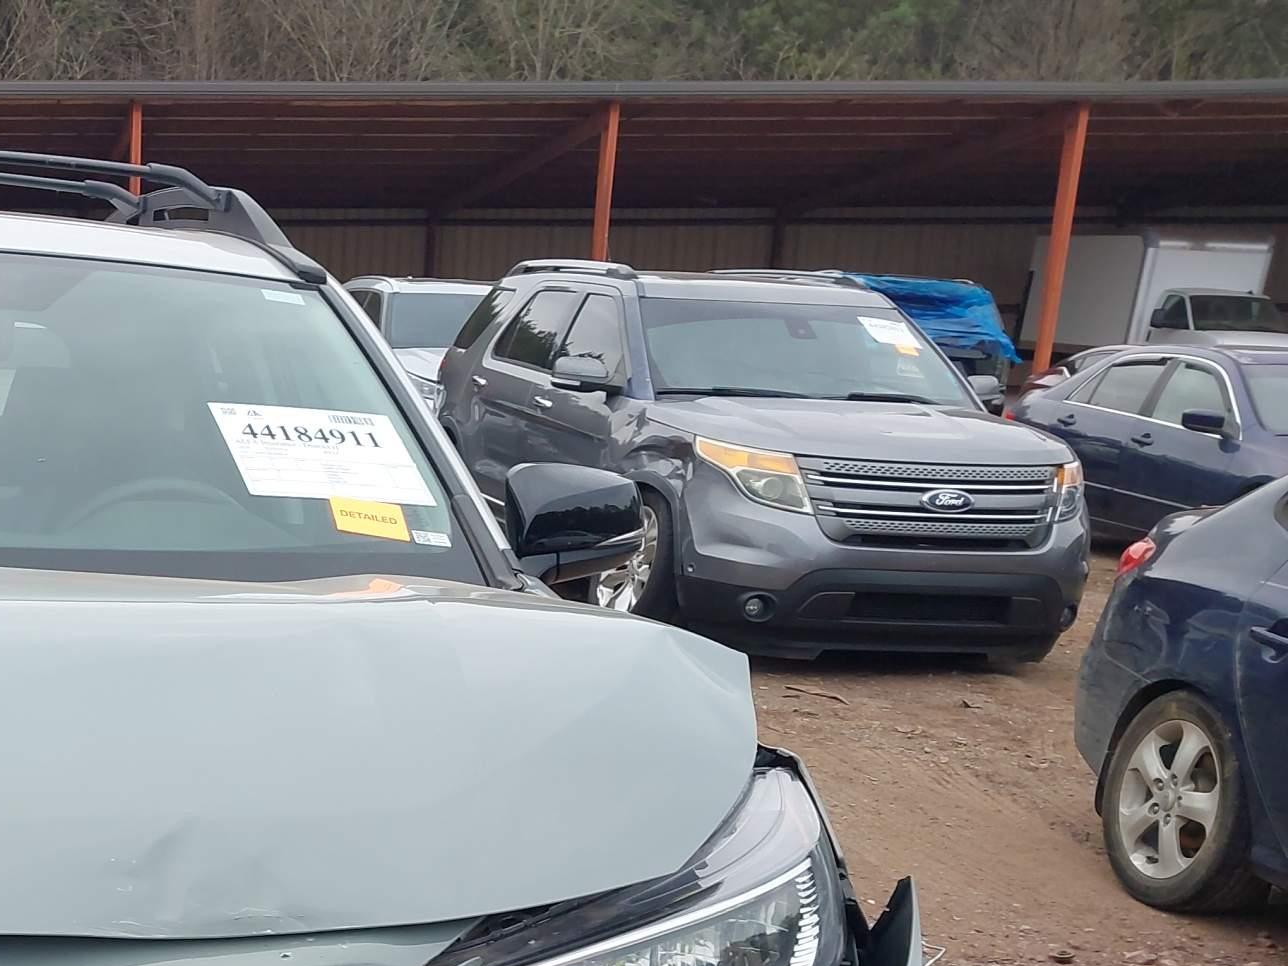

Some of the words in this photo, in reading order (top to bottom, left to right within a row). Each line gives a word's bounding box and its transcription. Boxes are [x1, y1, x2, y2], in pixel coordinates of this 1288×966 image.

[241, 423, 384, 449] 44184911
[935, 493, 964, 506] Ford
[339, 509, 398, 525] DETAILED
